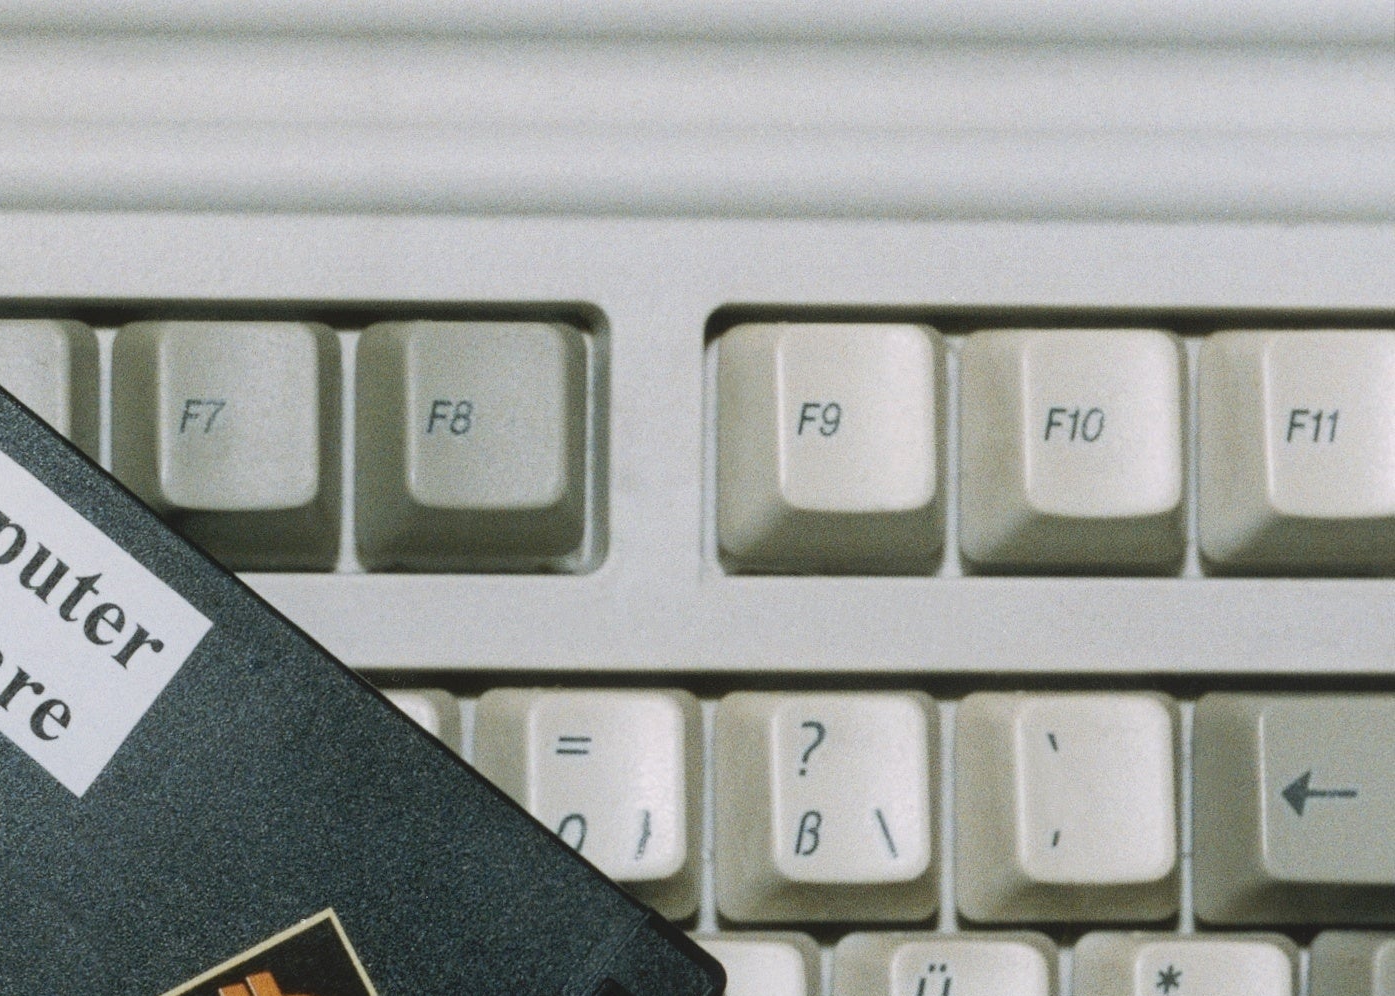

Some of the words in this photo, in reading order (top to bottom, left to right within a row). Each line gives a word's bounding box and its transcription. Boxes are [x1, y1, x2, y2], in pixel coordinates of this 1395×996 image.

[179, 398, 226, 434] F7
[425, 399, 473, 436] F8
[796, 401, 842, 438] F9
[1043, 406, 1105, 443] F10
[1285, 408, 1339, 443] F11
[798, 720, 827, 777] ?
